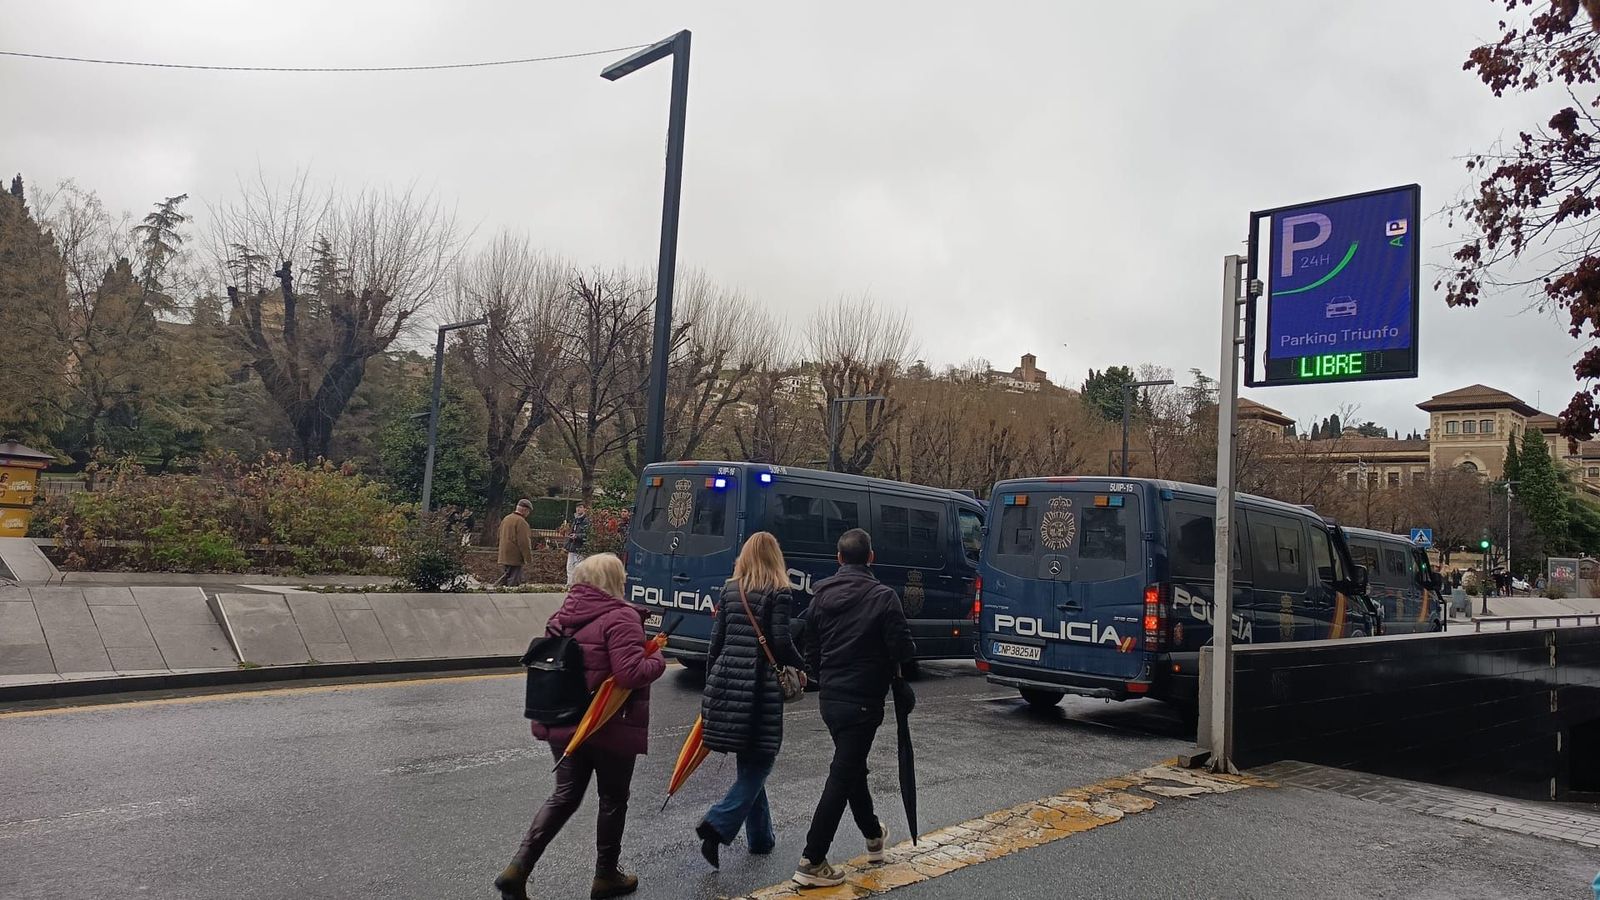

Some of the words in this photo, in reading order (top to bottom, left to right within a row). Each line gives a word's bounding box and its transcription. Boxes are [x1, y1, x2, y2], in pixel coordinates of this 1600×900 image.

[1281, 212, 1333, 278] P
[1300, 254, 1330, 269] 24H
[1281, 331, 1337, 347] Parking
[1341, 325, 1399, 341] Triunfo
[1300, 353, 1362, 377] LIBRE
[1109, 483, 1134, 492] 5UIP-15
[631, 584, 715, 613] POLICÍA
[994, 613, 1122, 646] POLICÍA
[998, 645, 1040, 659] CNP3825AV
